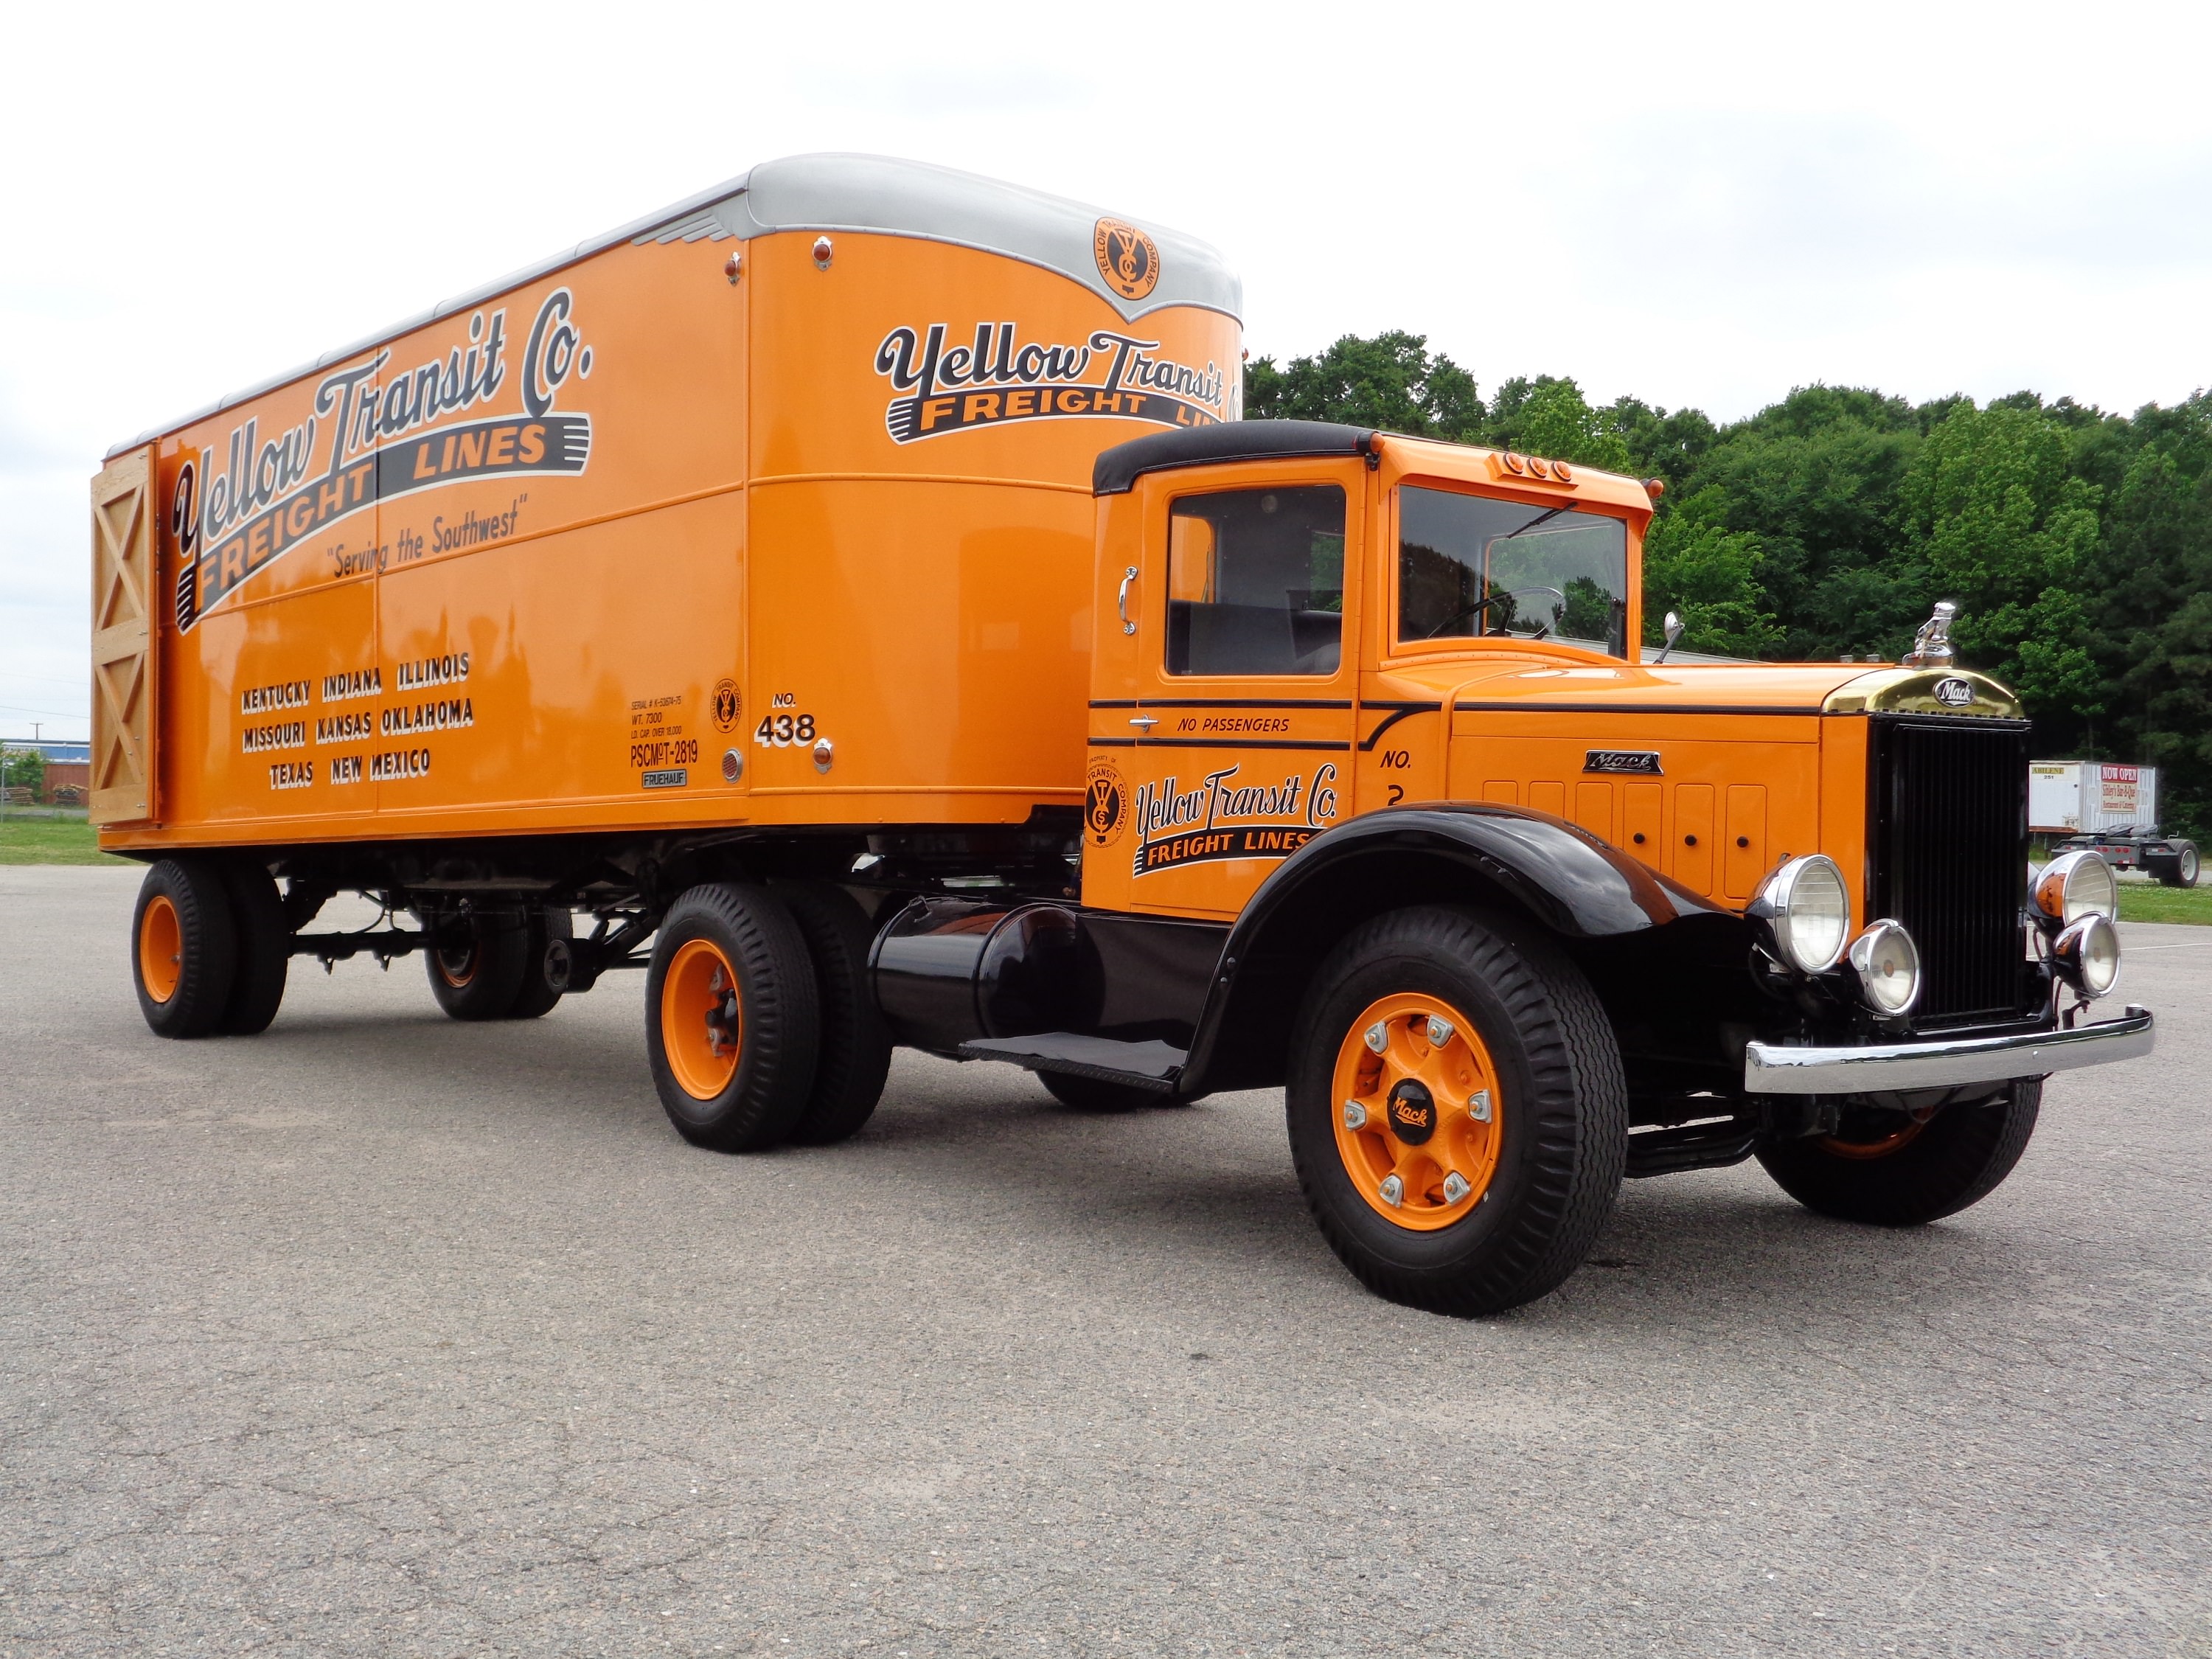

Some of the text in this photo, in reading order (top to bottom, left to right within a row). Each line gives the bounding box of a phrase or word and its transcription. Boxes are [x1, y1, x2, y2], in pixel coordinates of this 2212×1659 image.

[1097, 228, 1110, 275] YELLOW
[1142, 237, 1157, 288] COMPANY
[874, 321, 1090, 397] Yellow
[1088, 330, 1222, 410] Transit
[172, 286, 592, 567] Yellow Transit Co.
[919, 390, 1147, 431] FREIGHT
[194, 423, 546, 613] FREIGHT LINES
[397, 528, 424, 563] the
[241, 653, 470, 715] KENTUCKY INDIANA ILLINOIS
[771, 692, 796, 708] NO.
[1940, 680, 1971, 703] Mack
[631, 700, 647, 710] SERIAL
[631, 712, 662, 726] WT. 7300
[242, 698, 474, 754] MISSOURI KANSAS OKLAHOMA
[652, 727, 664, 737] OVER
[754, 714, 815, 748] 438
[1177, 718, 1290, 732] NO PASSENGERS
[269, 748, 431, 790] TEXAS NEW MEXICO
[1089, 755, 1107, 763] PROPERTY
[1380, 750, 1411, 768] NO.
[1589, 752, 1652, 771] Mack
[2102, 766, 2137, 781] NOW OPEN
[644, 772, 685, 786] FRUEHAUF
[1088, 768, 1127, 835] TRANSIT COMPANY
[1135, 762, 1338, 846] Yellow Transit Co.
[1387, 784, 1404, 807] 2
[1147, 831, 1310, 866] FREIGHT LINES
[1393, 1096, 1427, 1127] Mack
